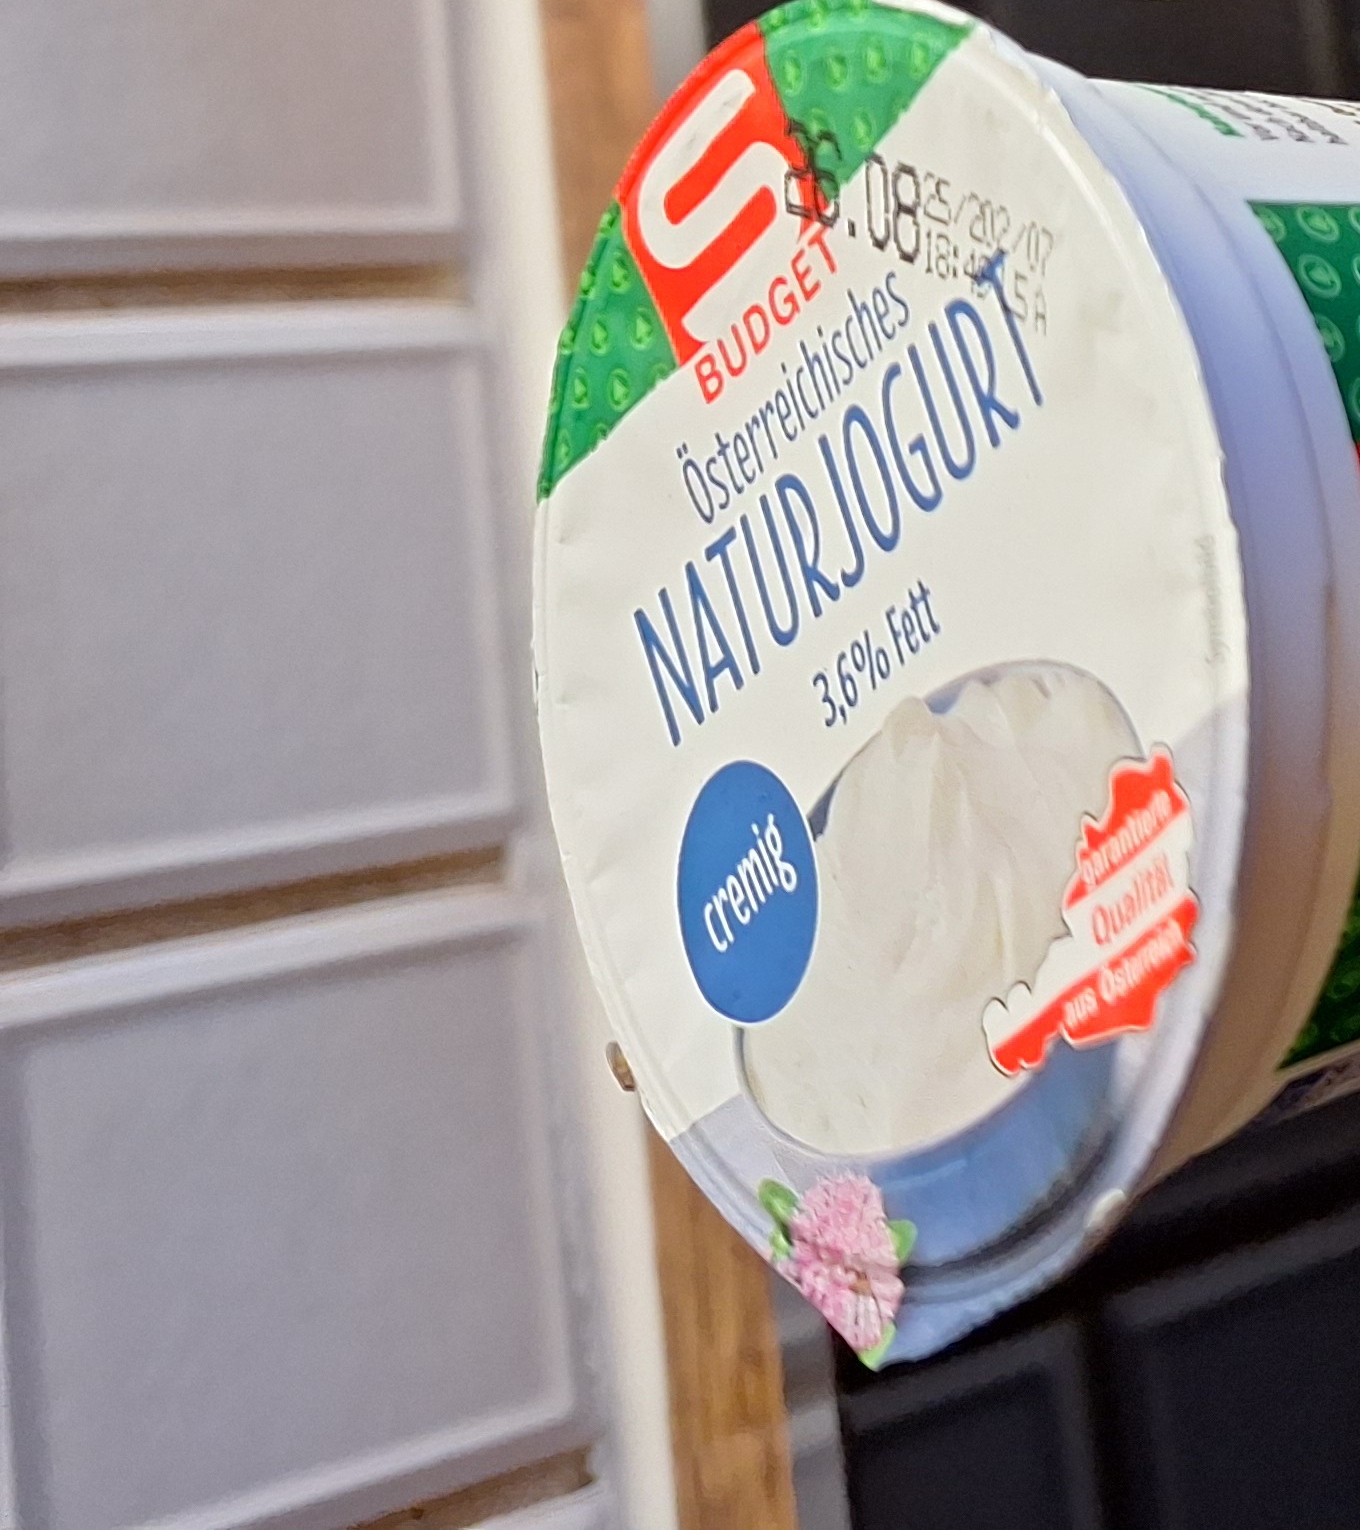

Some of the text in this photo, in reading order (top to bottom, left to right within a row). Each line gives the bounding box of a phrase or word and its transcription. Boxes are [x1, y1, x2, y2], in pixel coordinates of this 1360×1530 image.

[692, 224, 838, 405] BUDGET
[675, 271, 911, 525] Österreichisches
[633, 247, 1043, 747] NATURJOGURT
[811, 577, 941, 728] 3,6% Fett
[702, 813, 798, 954] cremig
[1059, 988, 1101, 1030] aus
